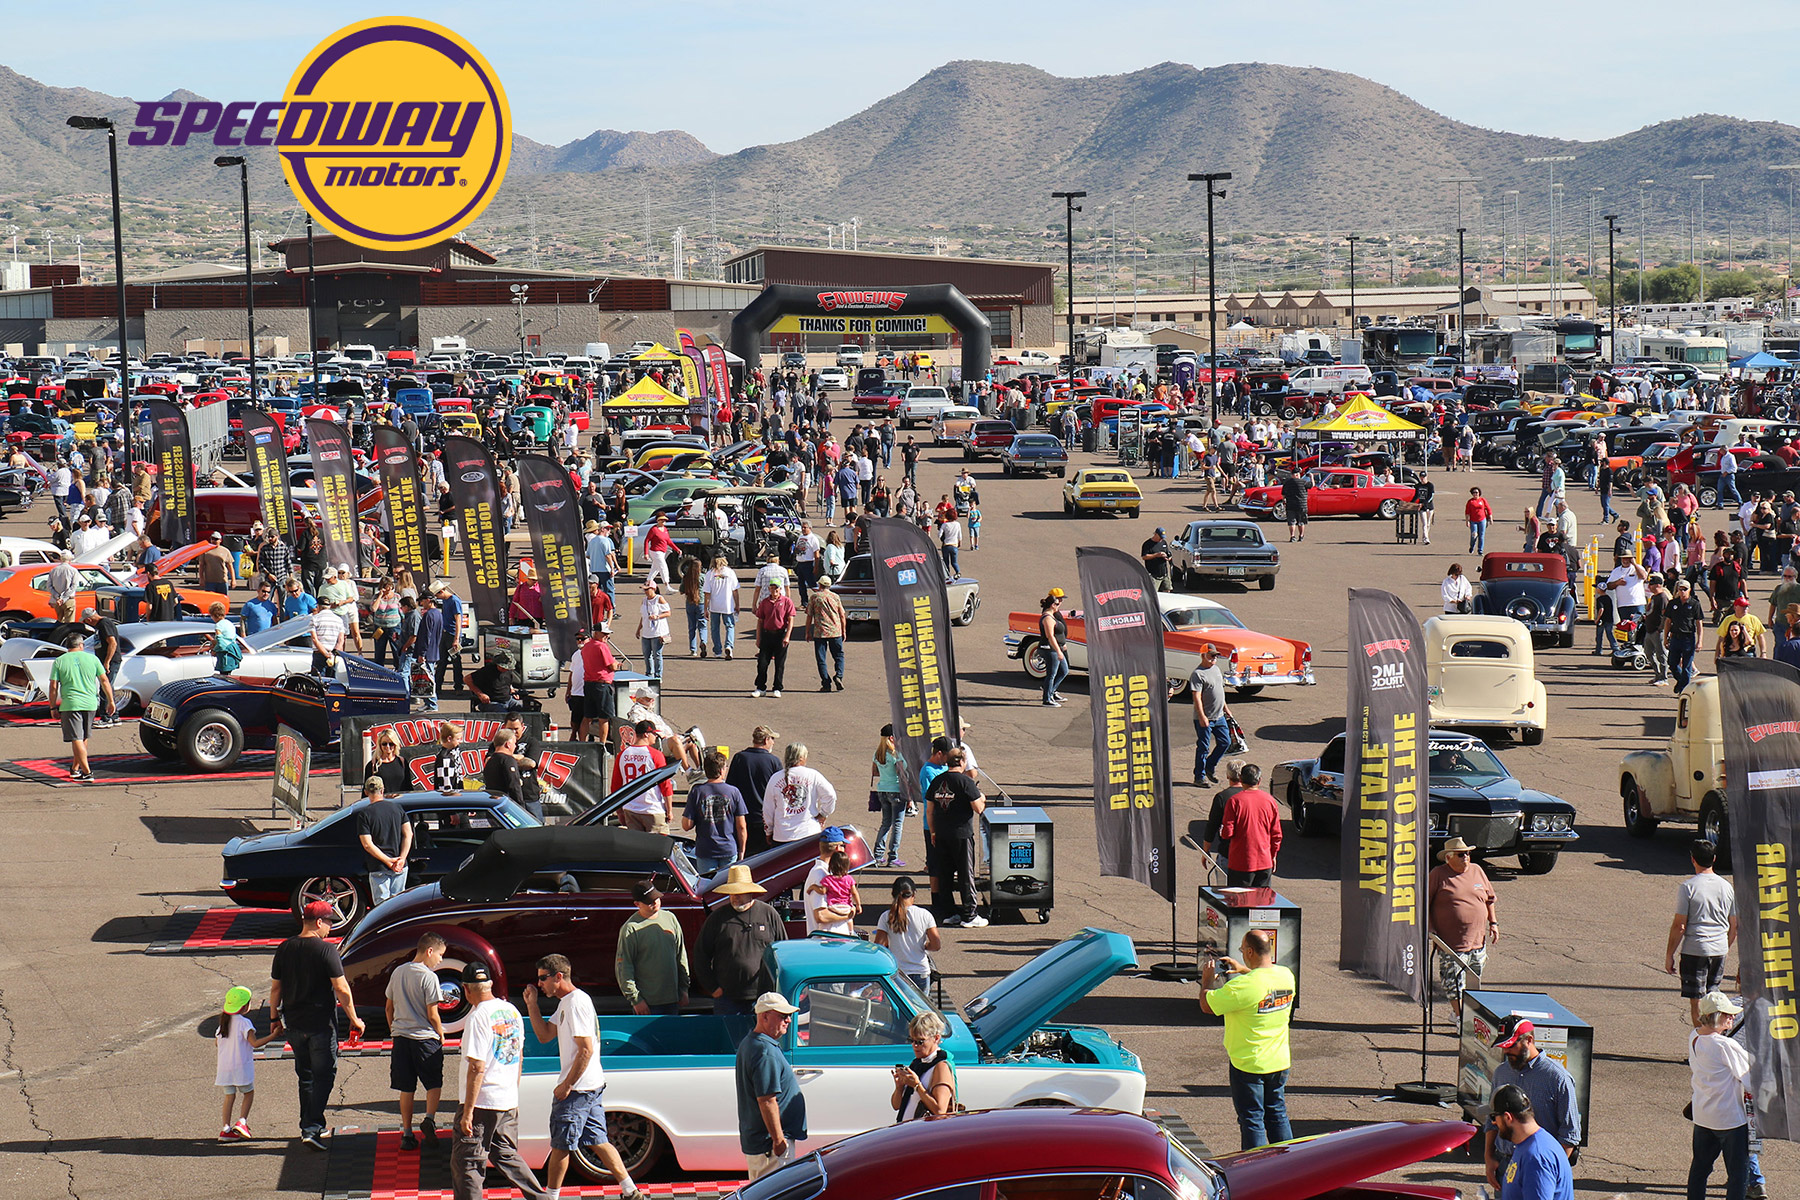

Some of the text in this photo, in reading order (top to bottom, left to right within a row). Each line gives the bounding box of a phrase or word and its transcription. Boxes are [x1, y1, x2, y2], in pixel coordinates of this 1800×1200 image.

[817, 291, 908, 311] GOODGUYS
[799, 318, 927, 332] THANKS FOR COMING!
[1331, 431, 1416, 441] www.good-guys.com
[1011, 848, 1032, 858] STREET
